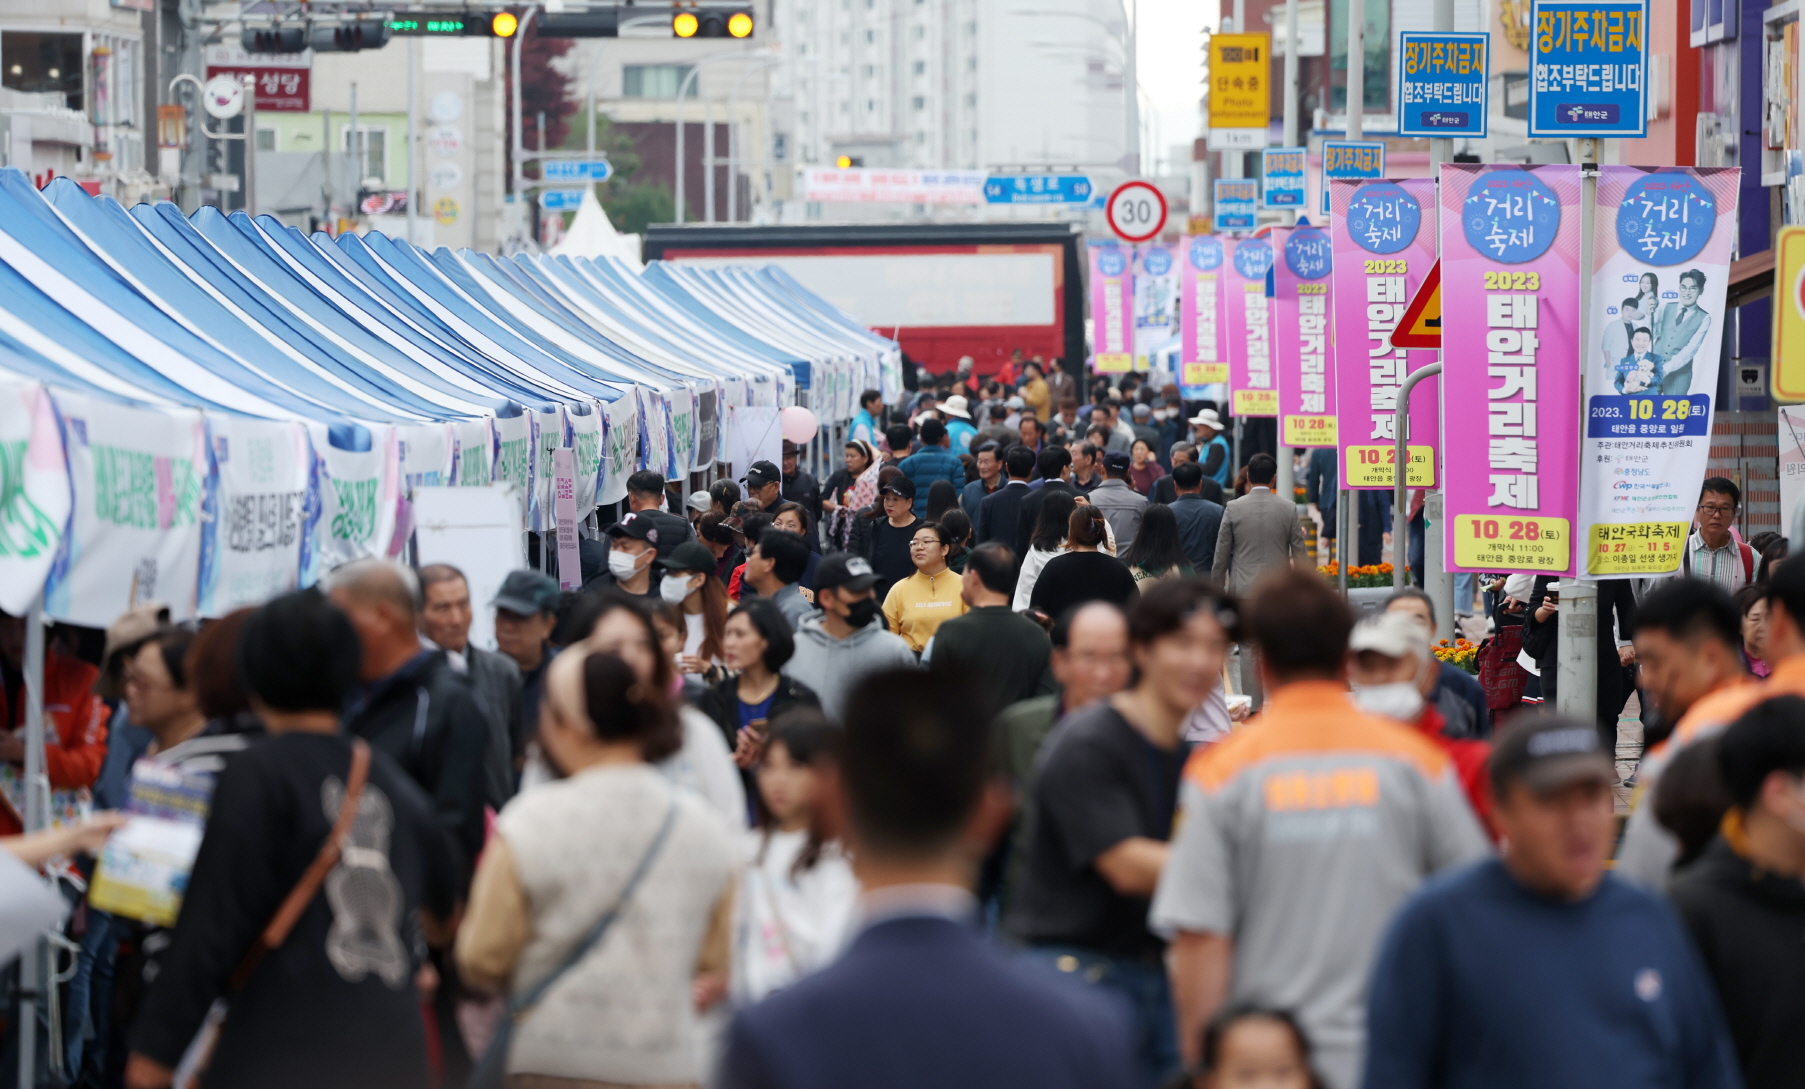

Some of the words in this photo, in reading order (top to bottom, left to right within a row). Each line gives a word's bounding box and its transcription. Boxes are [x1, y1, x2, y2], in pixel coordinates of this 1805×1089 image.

[1537, 10, 1642, 53] 장기주차금지
[1406, 42, 1484, 74] 장기주차금지
[1536, 63, 1640, 92] 협조부탁드립니다
[1404, 82, 1483, 104] 협조부탁드립니다
[1584, 111, 1608, 119] 태안군
[1326, 148, 1381, 171] 장기주차금지
[1121, 200, 1151, 225] 30
[1364, 200, 1400, 221] 거리
[1485, 192, 1533, 221] 거리
[1640, 194, 1689, 223] 거리
[1365, 218, 1401, 248] 축제
[1485, 216, 1534, 257] 축제
[1638, 219, 1688, 259] 축제
[1298, 239, 1322, 257] 거리
[1364, 259, 1407, 274] 2023
[1297, 283, 1327, 294] 2023
[1483, 271, 1540, 291] 2023
[1299, 295, 1327, 414] 태안거리축제
[1486, 294, 1540, 510] 태안거리축제
[1591, 407, 1623, 418] 2023.
[1629, 399, 1656, 419] 10.
[1662, 399, 1706, 420] 28(토)
[1611, 424, 1636, 434] 태안읍
[1639, 424, 1666, 434] 중앙로
[1596, 454, 1613, 463] 후원:
[620, 512, 638, 526] T
[1471, 519, 1503, 539] 10.
[1509, 520, 1560, 542] 28(토)
[1598, 523, 1680, 540] 태안국화축제
[1488, 543, 1515, 553] 개막식
[1519, 544, 1544, 553] 11:00
[1640, 554, 1655, 563] 선생
[1477, 554, 1503, 563] 태안읍
[1508, 554, 1534, 564] 중앙로
[1537, 556, 1554, 565] 광장
